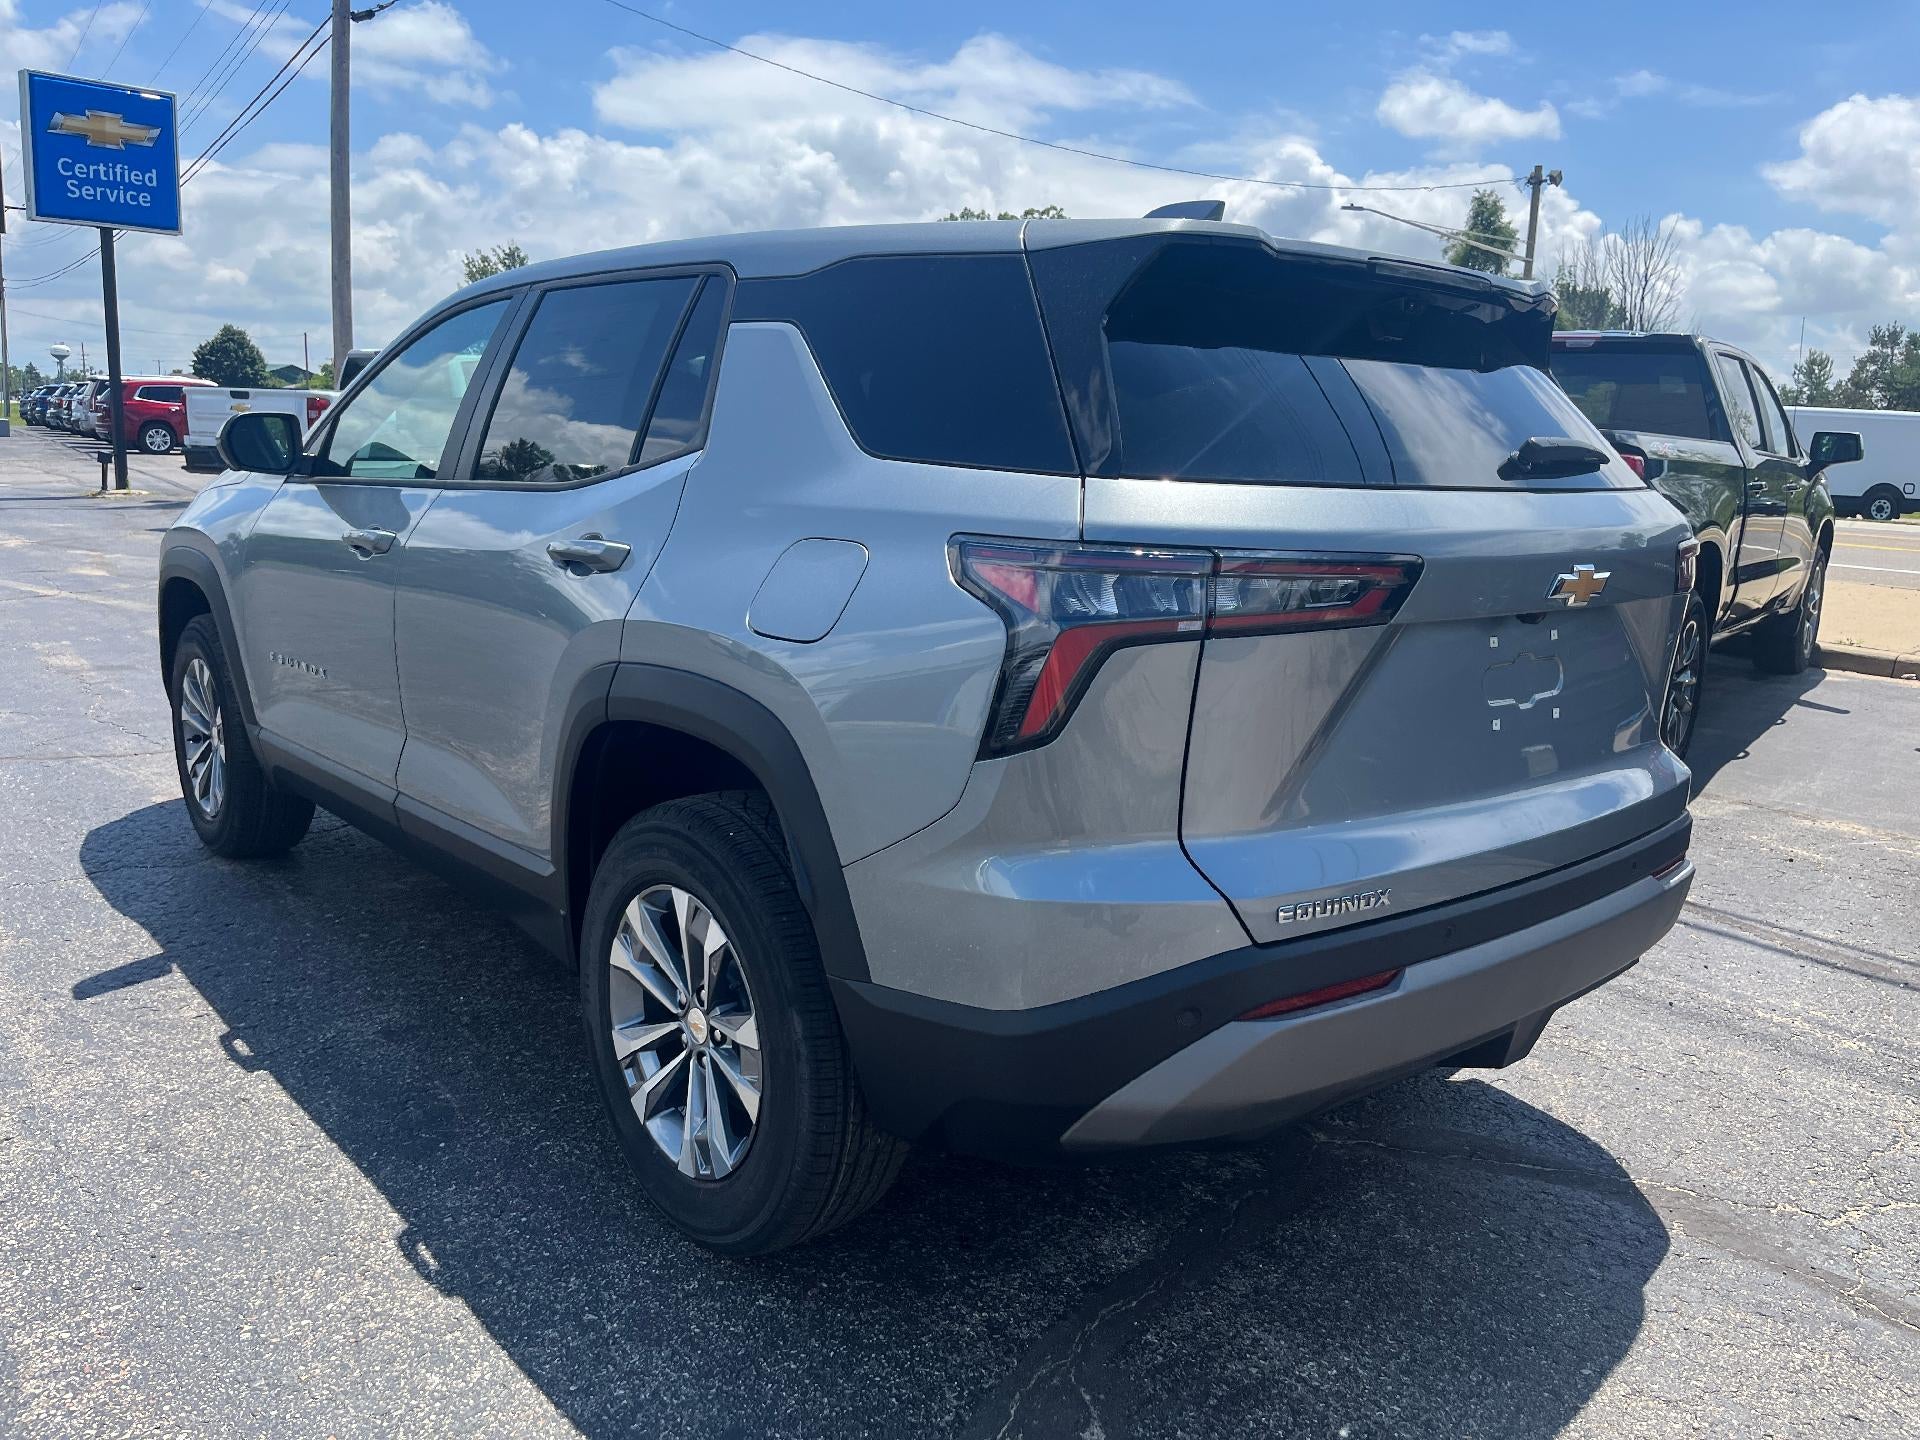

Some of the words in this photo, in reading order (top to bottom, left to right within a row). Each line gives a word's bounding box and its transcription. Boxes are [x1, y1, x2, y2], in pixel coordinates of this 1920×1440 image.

[57, 157, 157, 188] Certified
[66, 179, 151, 207] Service
[1278, 888, 1392, 924] EQUINOX
